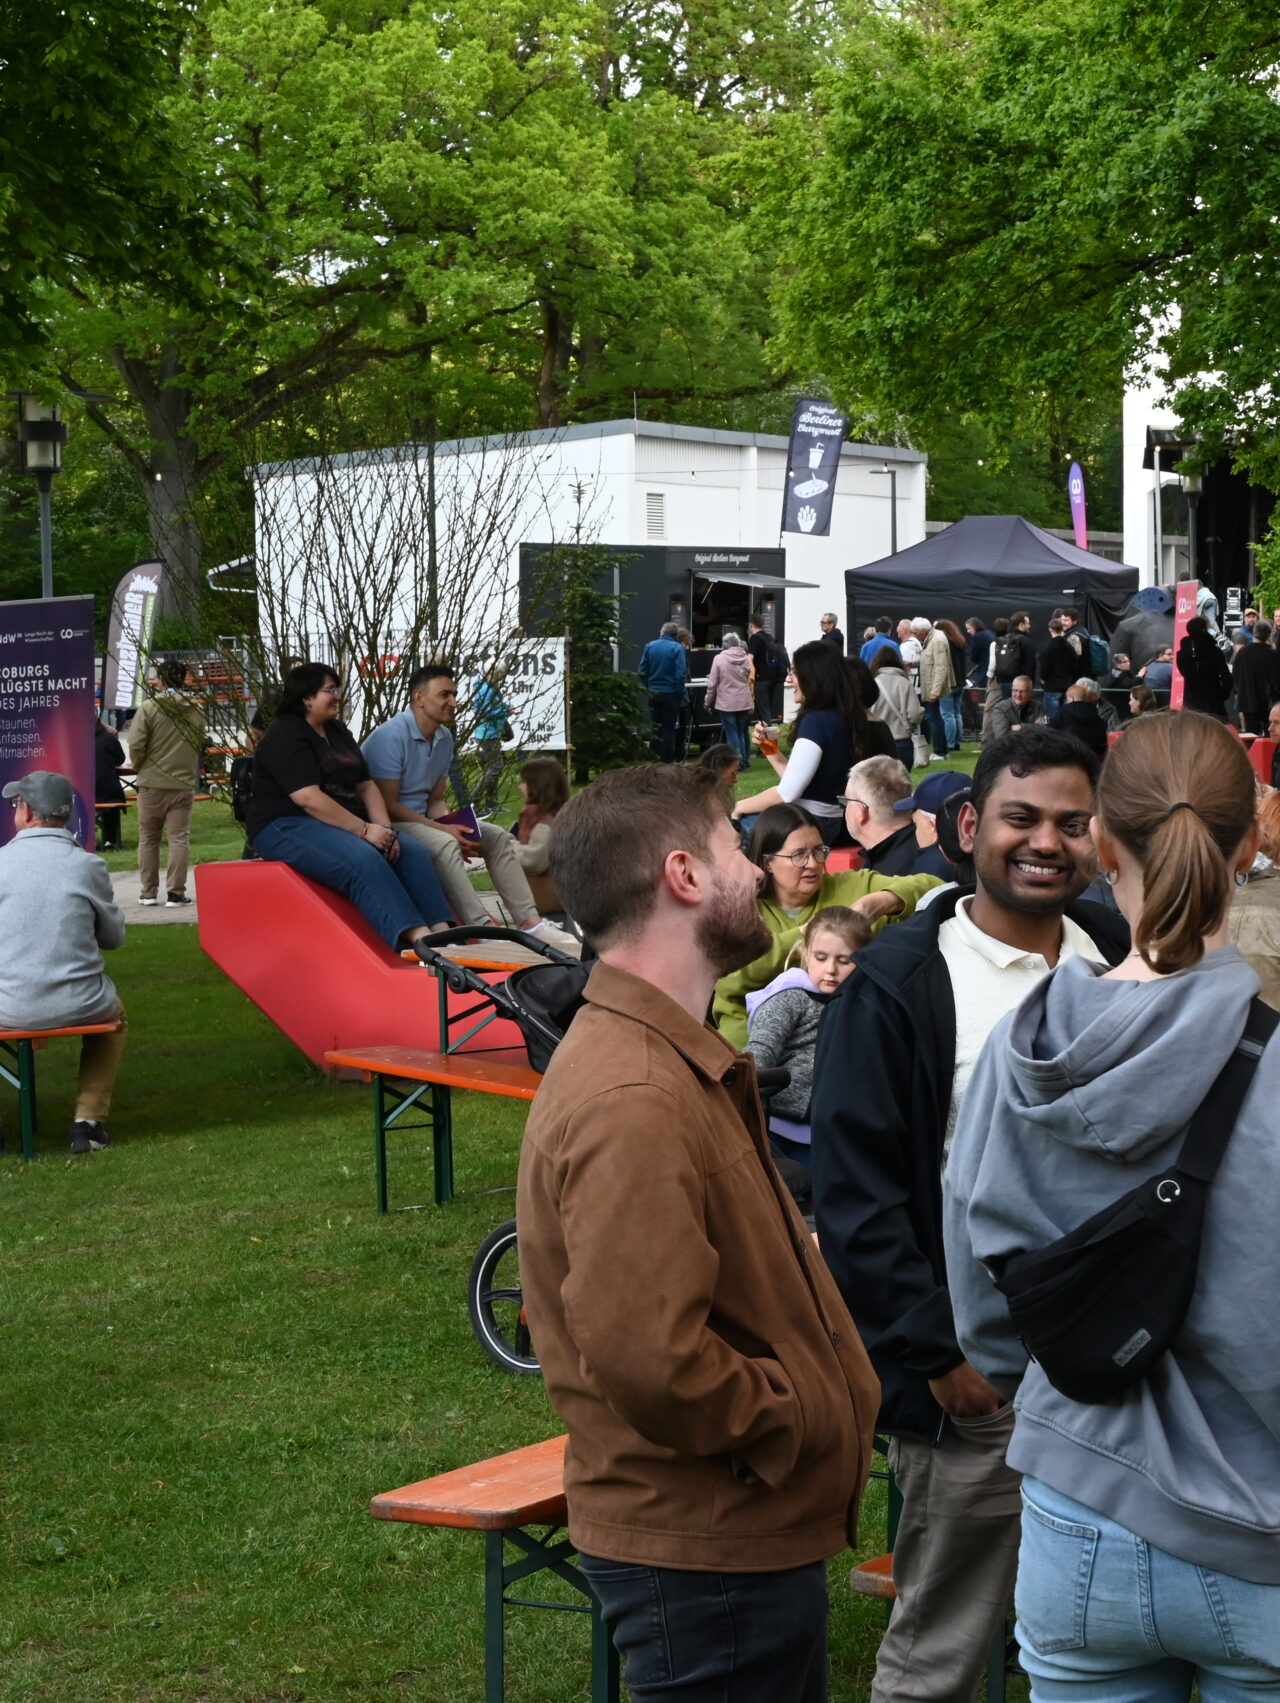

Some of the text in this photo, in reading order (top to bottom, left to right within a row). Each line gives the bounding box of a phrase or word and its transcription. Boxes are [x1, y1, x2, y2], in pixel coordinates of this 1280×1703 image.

[799, 412, 843, 427] Berliner
[0, 664, 50, 679] OBURGS
[47, 677, 88, 691] NACHT
[0, 694, 60, 712] ES JAHRES
